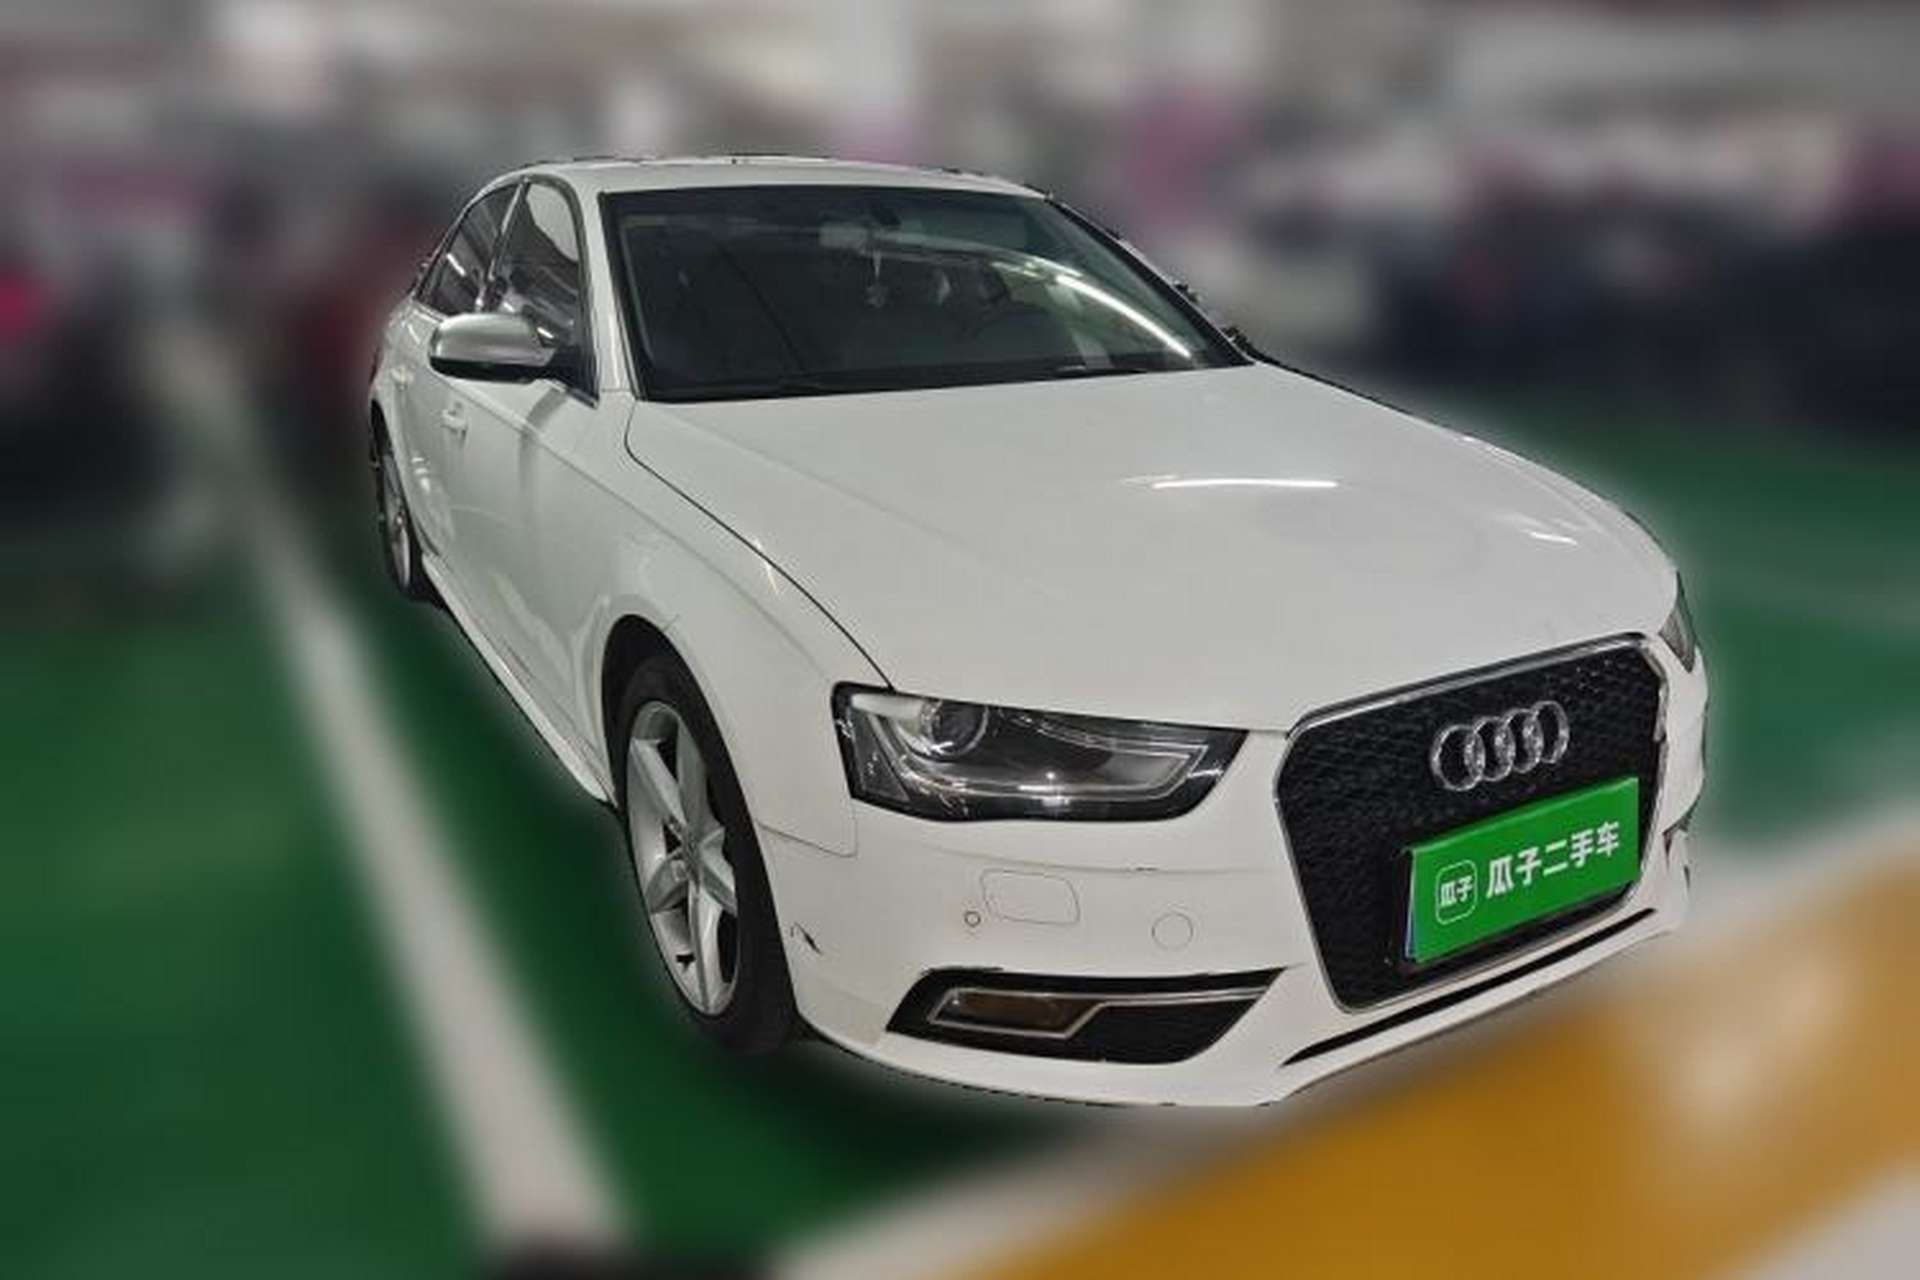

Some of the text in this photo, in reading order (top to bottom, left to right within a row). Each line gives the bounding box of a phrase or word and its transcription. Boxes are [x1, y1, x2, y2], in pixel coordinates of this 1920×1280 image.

[1485, 821, 1620, 899] 瓜子二手车
[1440, 875, 1473, 907] 瓜子
